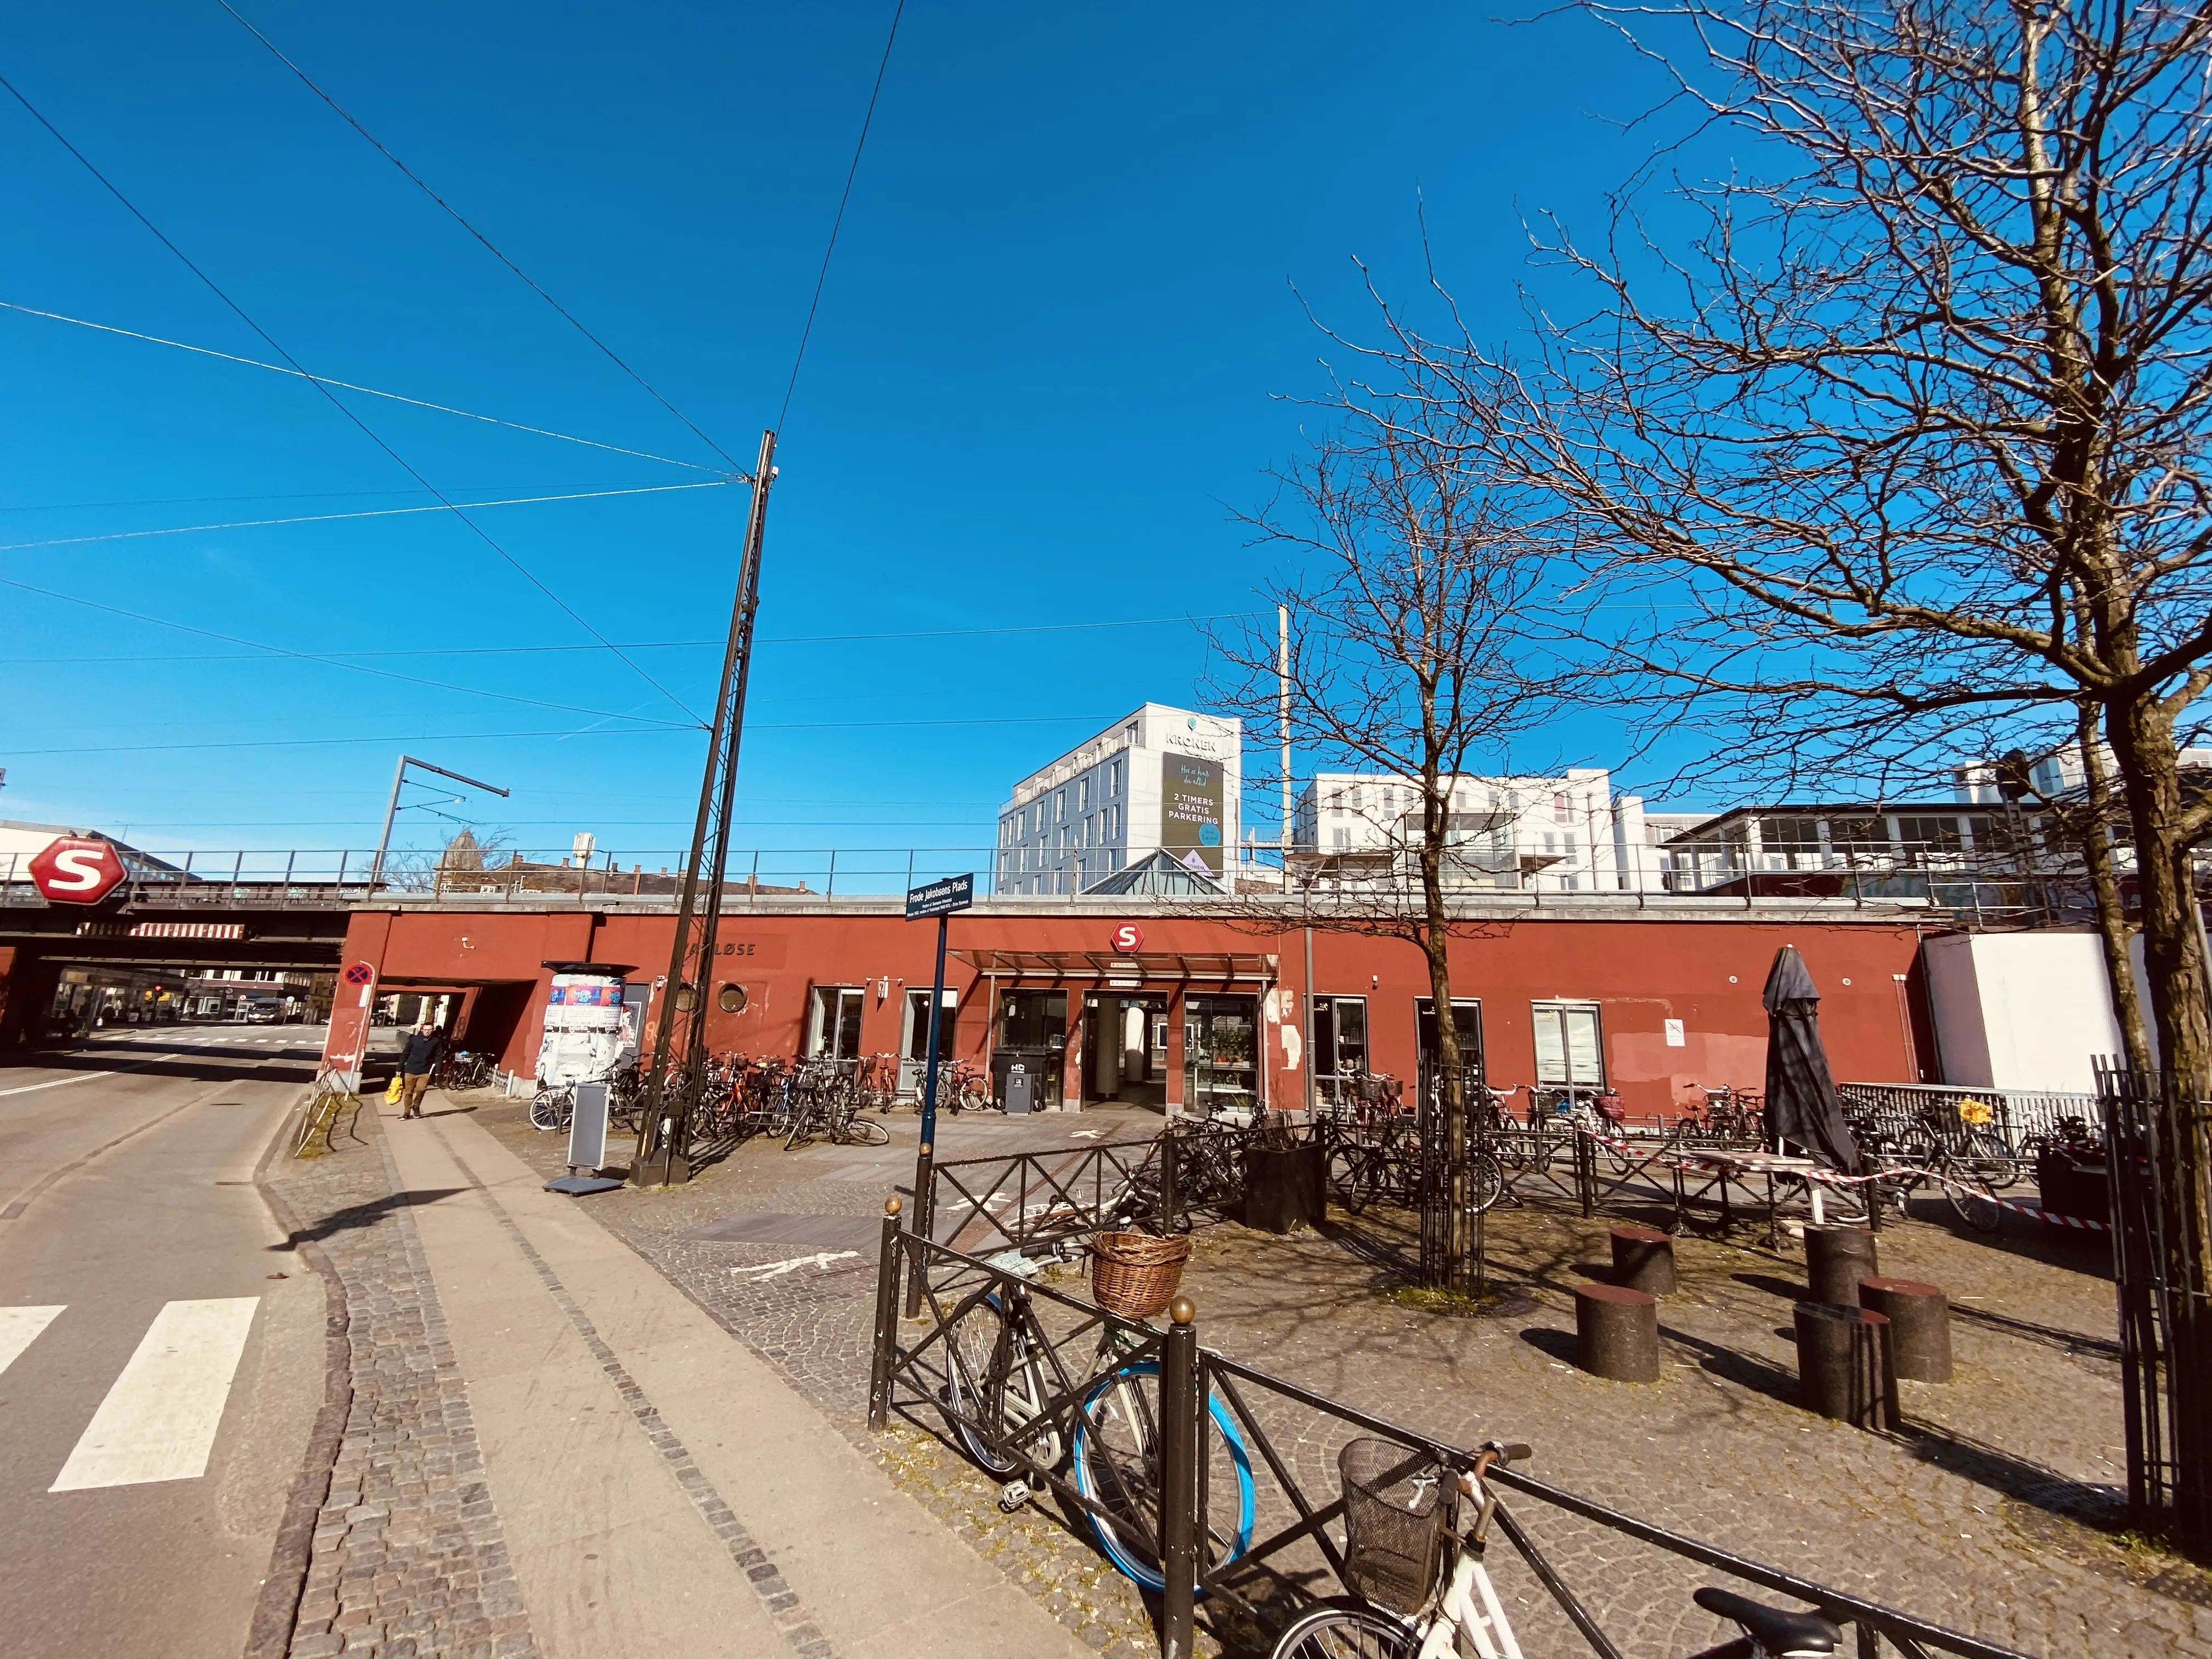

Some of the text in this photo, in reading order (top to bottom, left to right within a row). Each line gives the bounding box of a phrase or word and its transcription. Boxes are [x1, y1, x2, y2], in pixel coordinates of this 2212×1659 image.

[1166, 733, 1216, 752] KRONEN
[1178, 803, 1209, 814] GRATIS
[1182, 794, 1214, 806] TIMERS
[1169, 810, 1218, 825] PARKERING
[48, 849, 104, 890] S
[909, 891, 924, 904] Frode
[924, 885, 951, 901] Jakobsens
[952, 879, 968, 893] Plads
[1119, 927, 1136, 946] S
[682, 943, 755, 956] ALØSE
